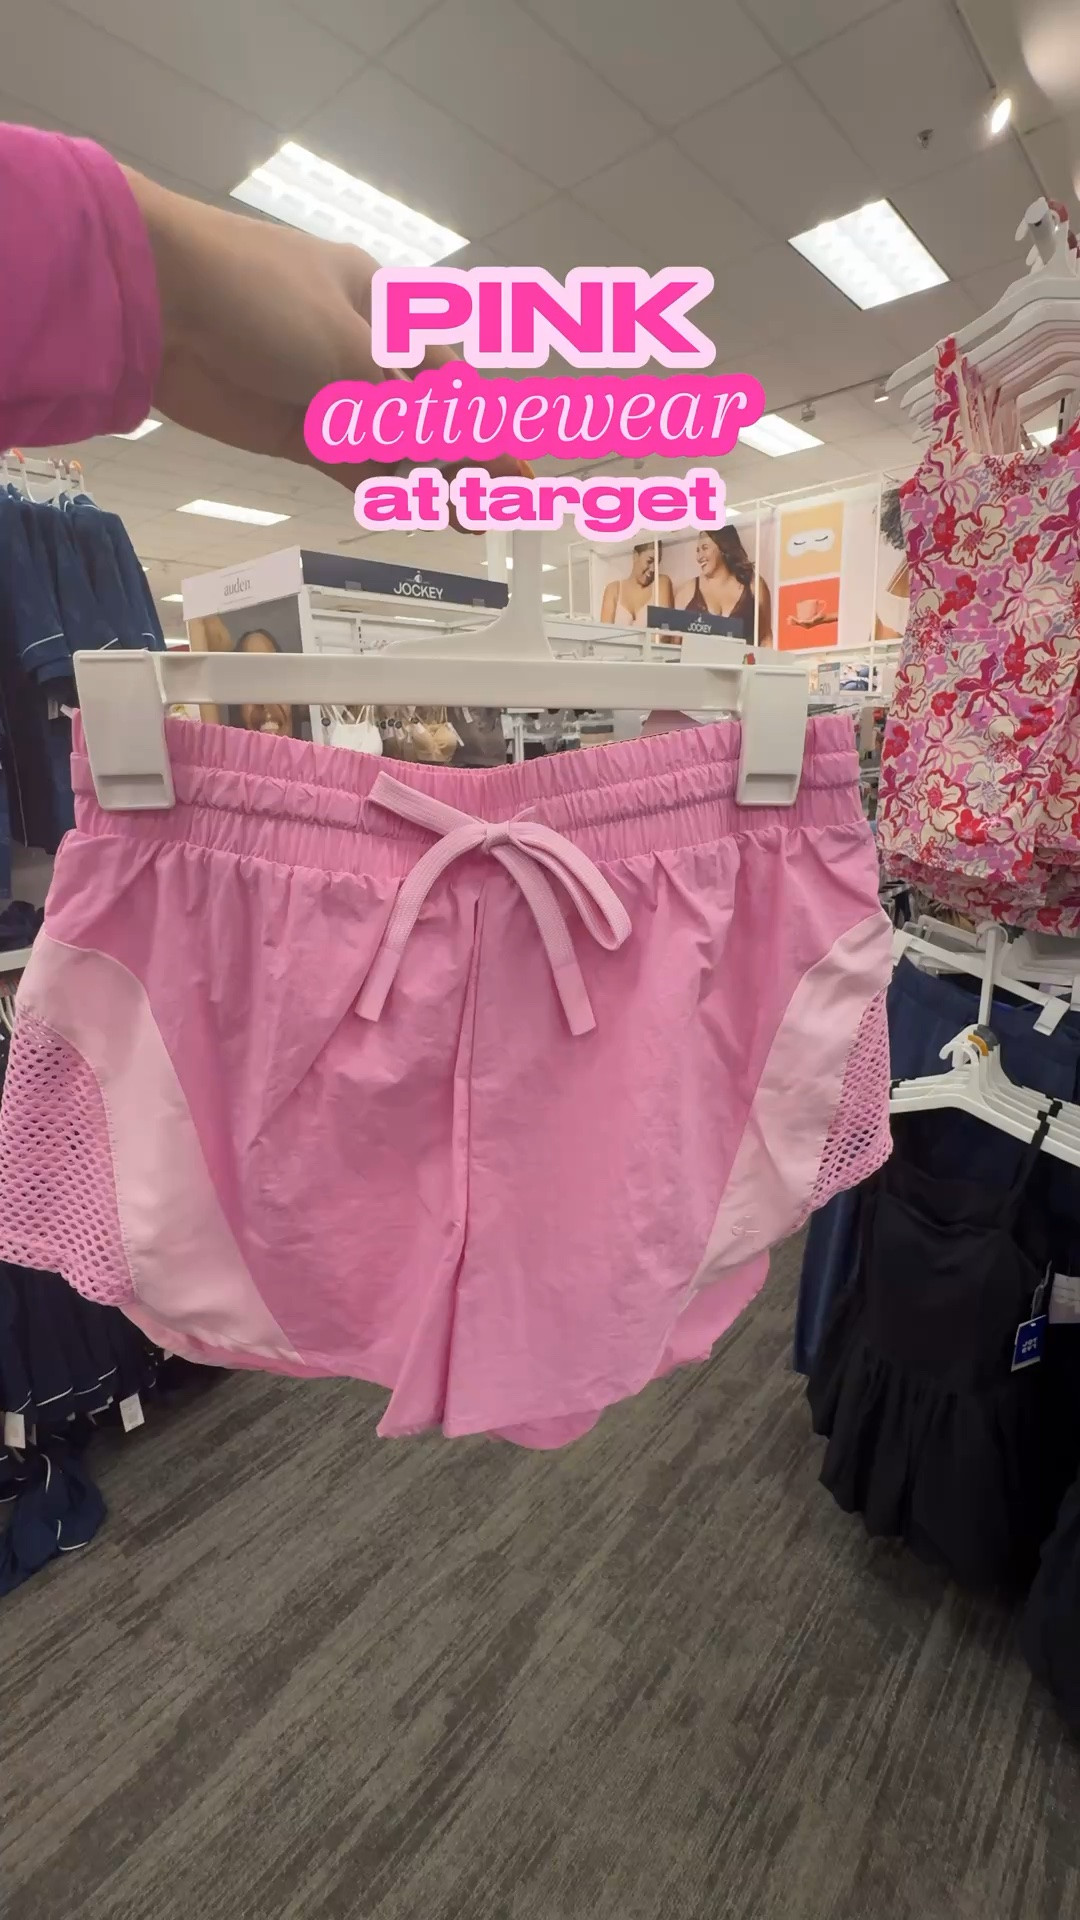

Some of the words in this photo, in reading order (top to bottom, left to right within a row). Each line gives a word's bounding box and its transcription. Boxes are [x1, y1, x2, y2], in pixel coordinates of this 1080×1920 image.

[223, 577, 251, 597] auden
[393, 581, 444, 600] JOCKEY
[687, 622, 712, 633] JOCKEY
